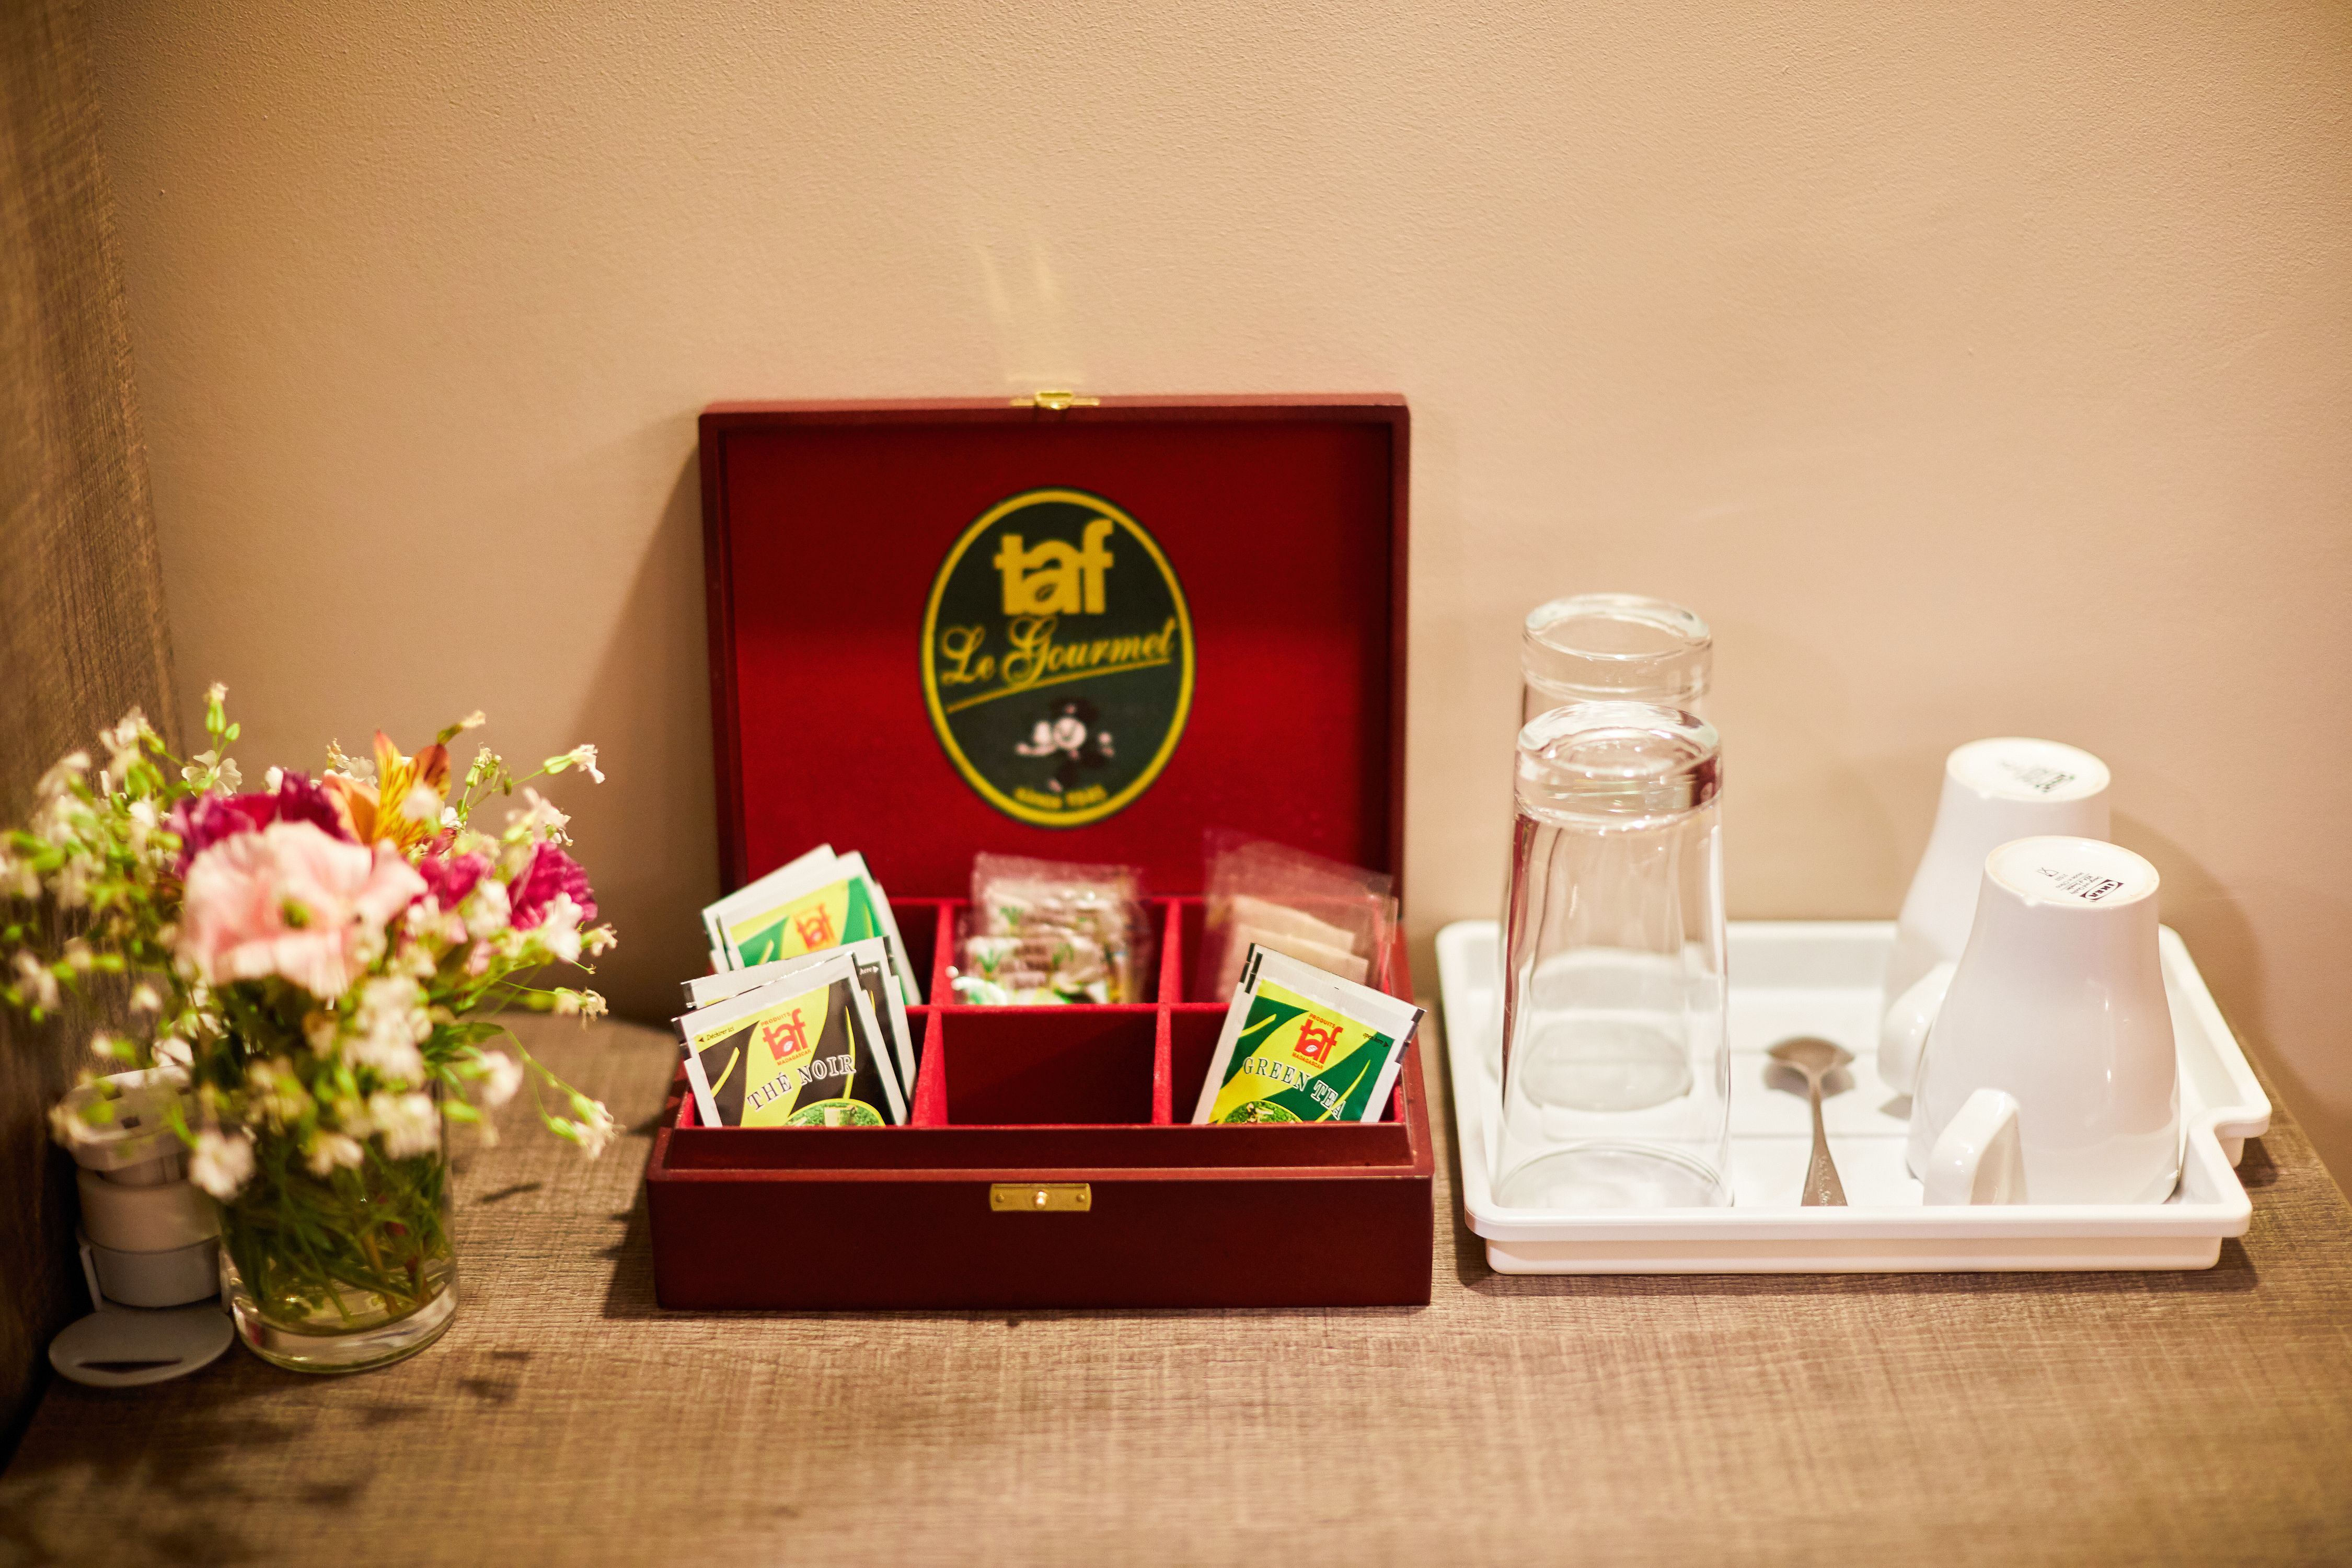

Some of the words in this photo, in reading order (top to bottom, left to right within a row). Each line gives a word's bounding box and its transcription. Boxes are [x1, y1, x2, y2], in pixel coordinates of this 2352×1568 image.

[994, 518, 1114, 615] taf
[941, 626, 994, 685] Le
[1001, 615, 1175, 688] Gourmet
[2088, 883, 2115, 897] IKEA
[796, 903, 837, 951] taf
[761, 1011, 791, 1026] PRODUITS
[762, 1008, 808, 1060] taf
[1294, 1019, 1344, 1065] taf
[1309, 1013, 1336, 1029] PRODUITS
[777, 1048, 812, 1066] MADAGASCAR
[1292, 1051, 1324, 1070] MADAGASCAR
[746, 1071, 792, 1112] THÉ
[796, 1054, 857, 1087] NOIR
[1242, 1056, 1312, 1092] GREEN
[1310, 1079, 1346, 1121] TEA
